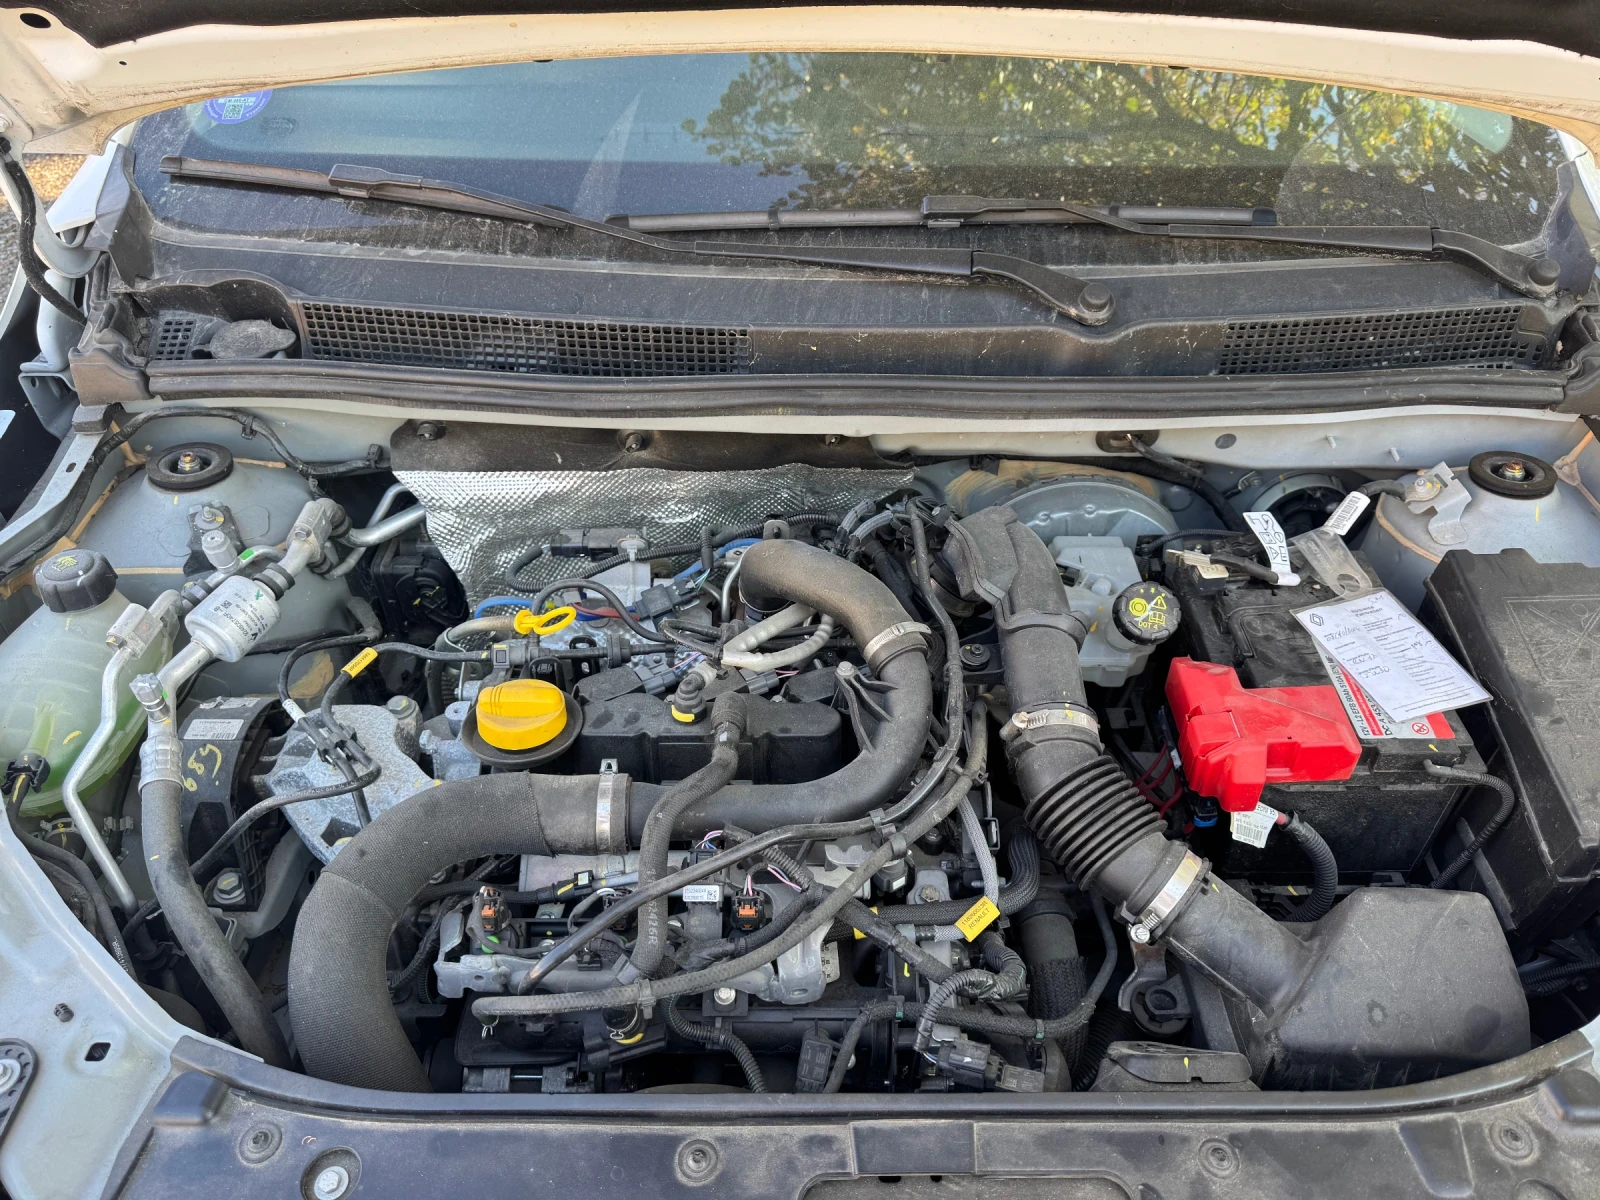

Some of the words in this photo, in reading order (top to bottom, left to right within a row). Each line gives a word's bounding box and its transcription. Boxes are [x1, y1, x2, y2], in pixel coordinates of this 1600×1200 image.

[1138, 620, 1151, 629] DOT
[1335, 676, 1346, 688] 510A
[1341, 689, 1353, 701] 60Ah
[1348, 702, 1359, 714] EFB
[1359, 725, 1370, 735] 12V
[967, 907, 989, 929] RENAULT
